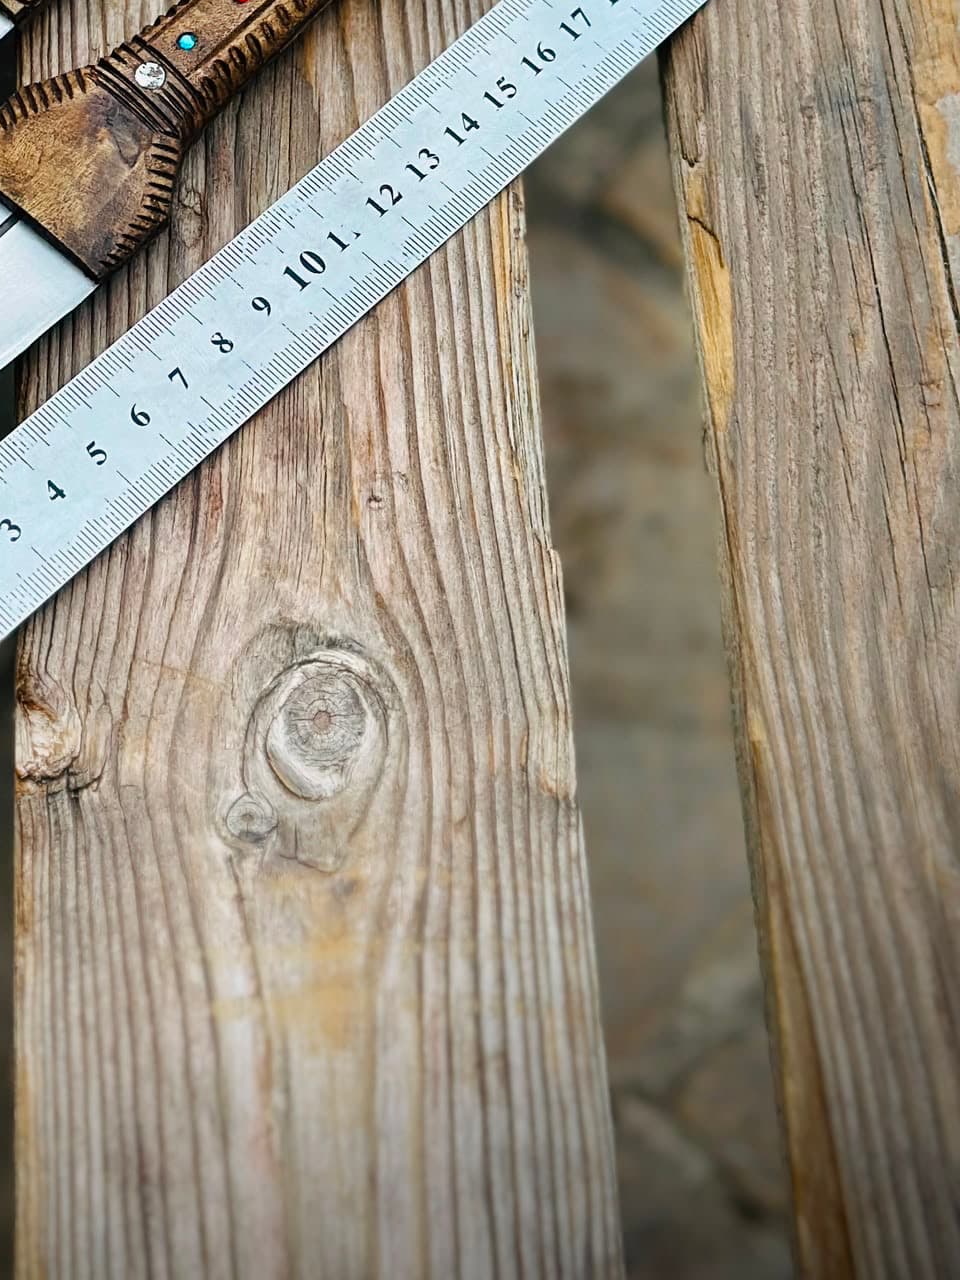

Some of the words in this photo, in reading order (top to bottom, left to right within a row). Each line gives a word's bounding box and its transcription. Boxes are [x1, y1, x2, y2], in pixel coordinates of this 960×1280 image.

[0, 518, 22, 542] 3
[46, 479, 66, 502] 4
[86, 441, 107, 465] 5
[130, 403, 150, 427] 6
[168, 367, 189, 390] 7
[211, 332, 234, 353] 8
[251, 296, 271, 316] 9
[283, 250, 326, 291] 10
[365, 184, 403, 217] 12
[404, 147, 440, 182] 13
[444, 112, 480, 147] 14
[483, 76, 517, 111] 15
[521, 41, 556, 76] 16
[559, 7, 592, 41] 17
